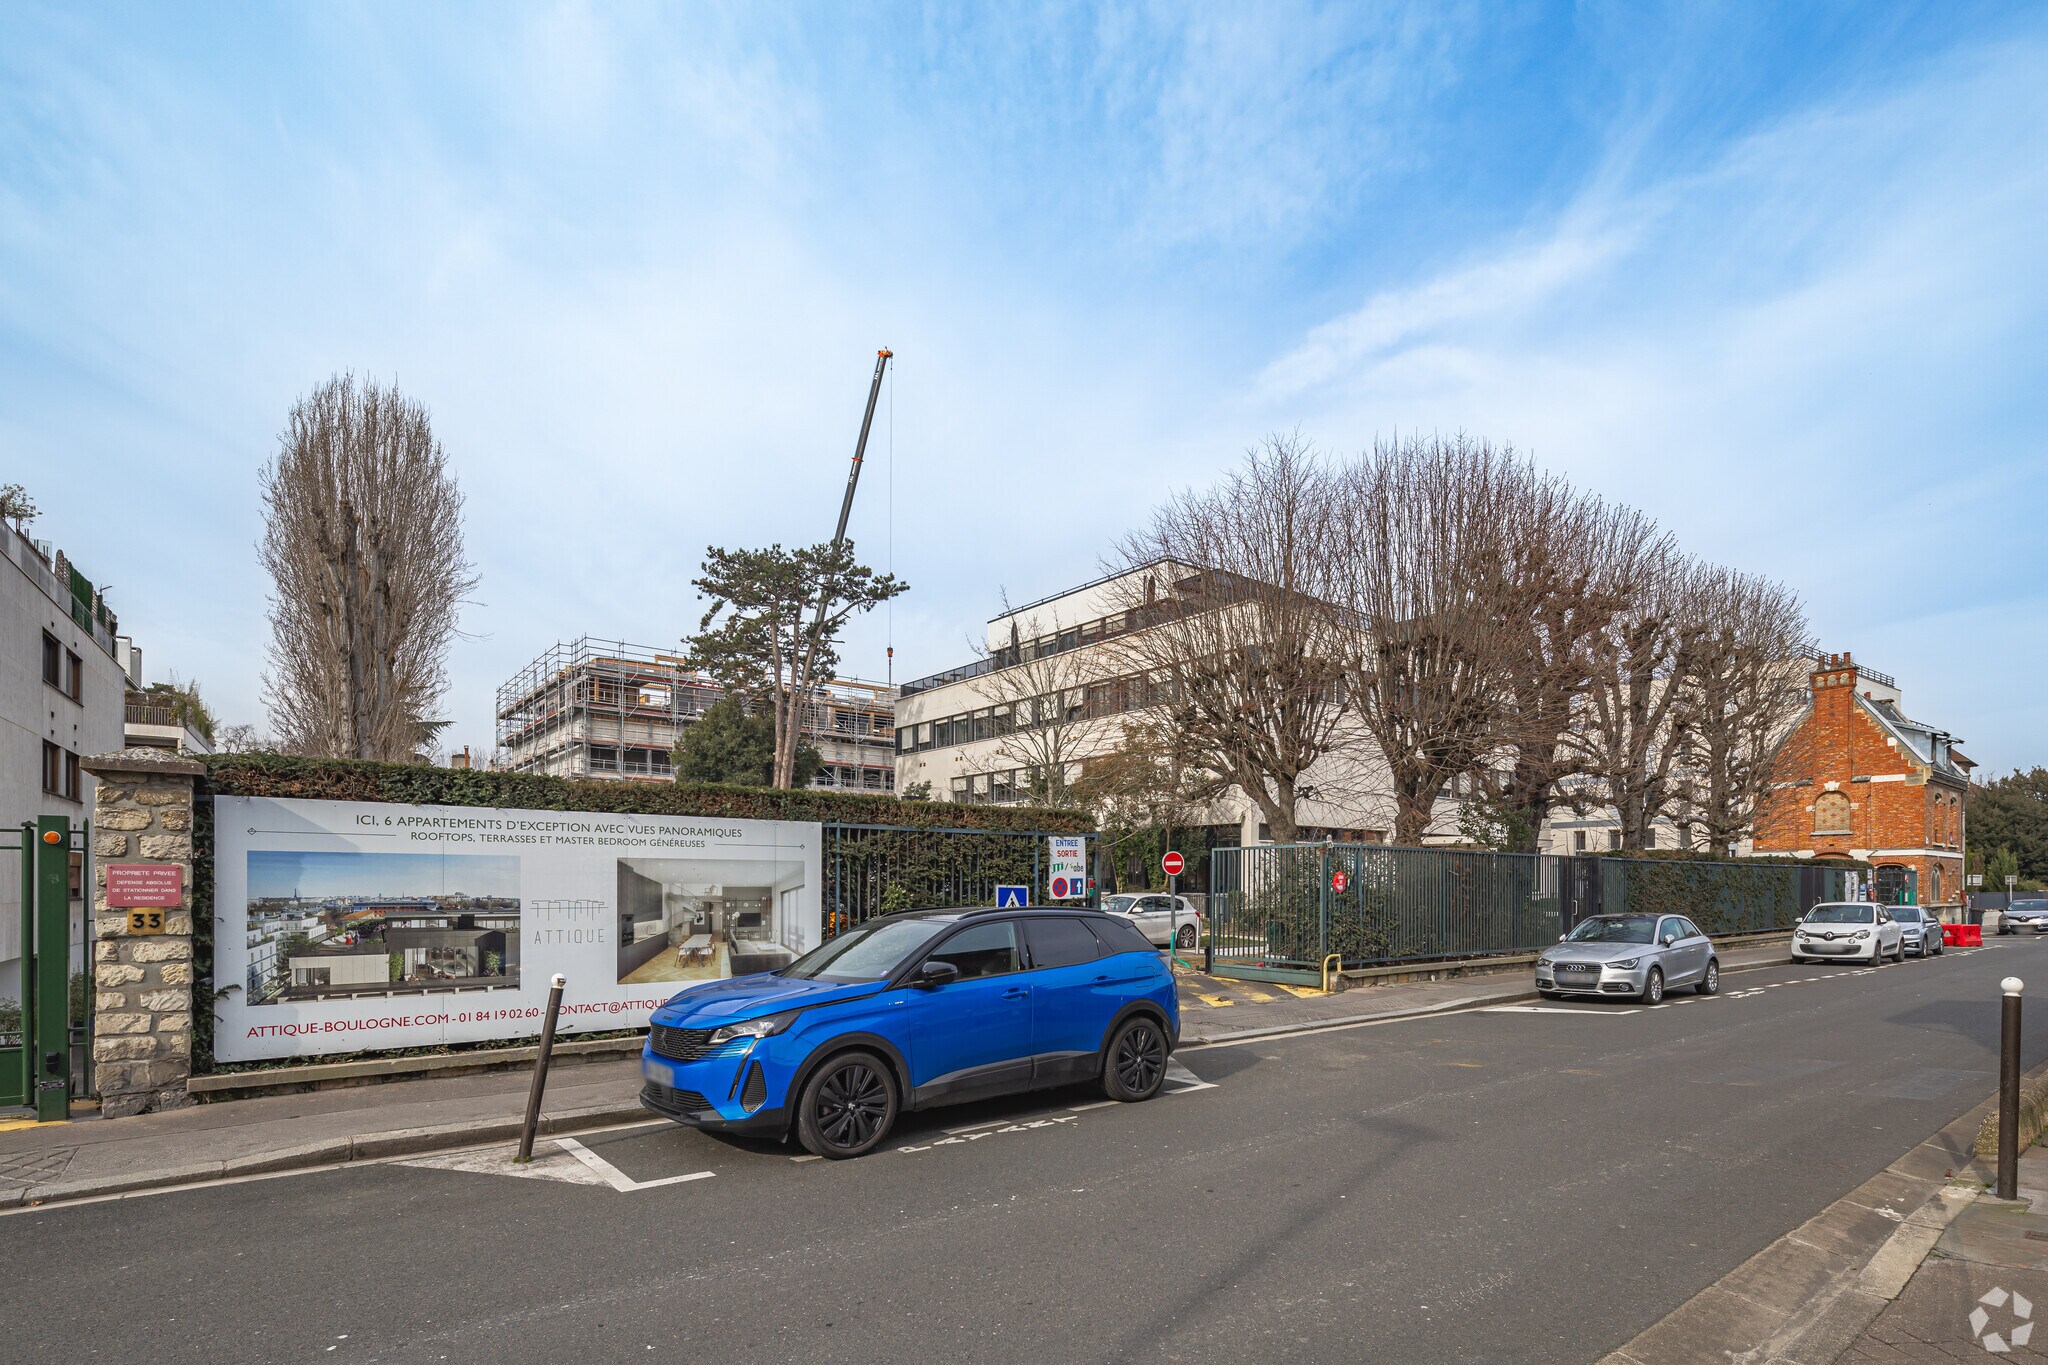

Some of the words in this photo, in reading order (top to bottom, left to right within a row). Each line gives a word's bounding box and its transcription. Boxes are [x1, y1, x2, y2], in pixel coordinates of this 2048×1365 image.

[356, 814, 379, 826] ICI,
[384, 815, 392, 826] 6
[397, 816, 502, 830] APPARTEMENTS
[507, 820, 591, 832] D'EXCEPTION
[594, 824, 625, 834] AVEC
[628, 825, 656, 836] VUES
[659, 826, 743, 839] PANORAMIQUES
[411, 831, 476, 843] ROOFTOPS,
[479, 833, 537, 844] TERRASSES
[540, 835, 553, 844] ET
[556, 836, 595, 845] MASTER
[598, 837, 647, 847] BEDROOM
[650, 837, 706, 848] GÉNÉREUSES
[1057, 850, 1079, 858] SORTIE
[132, 913, 161, 929] 33
[534, 929, 605, 945] ATTIQUE
[247, 1014, 449, 1038] ATTIQUE-BOULOGNE.COM
[459, 1012, 471, 1023] 01
[475, 1011, 490, 1021] 84
[494, 1010, 507, 1020] 19
[509, 1008, 523, 1019] 02
[525, 1007, 539, 1018] 60
[558, 998, 668, 1016] ONTACT@ATTIQU
